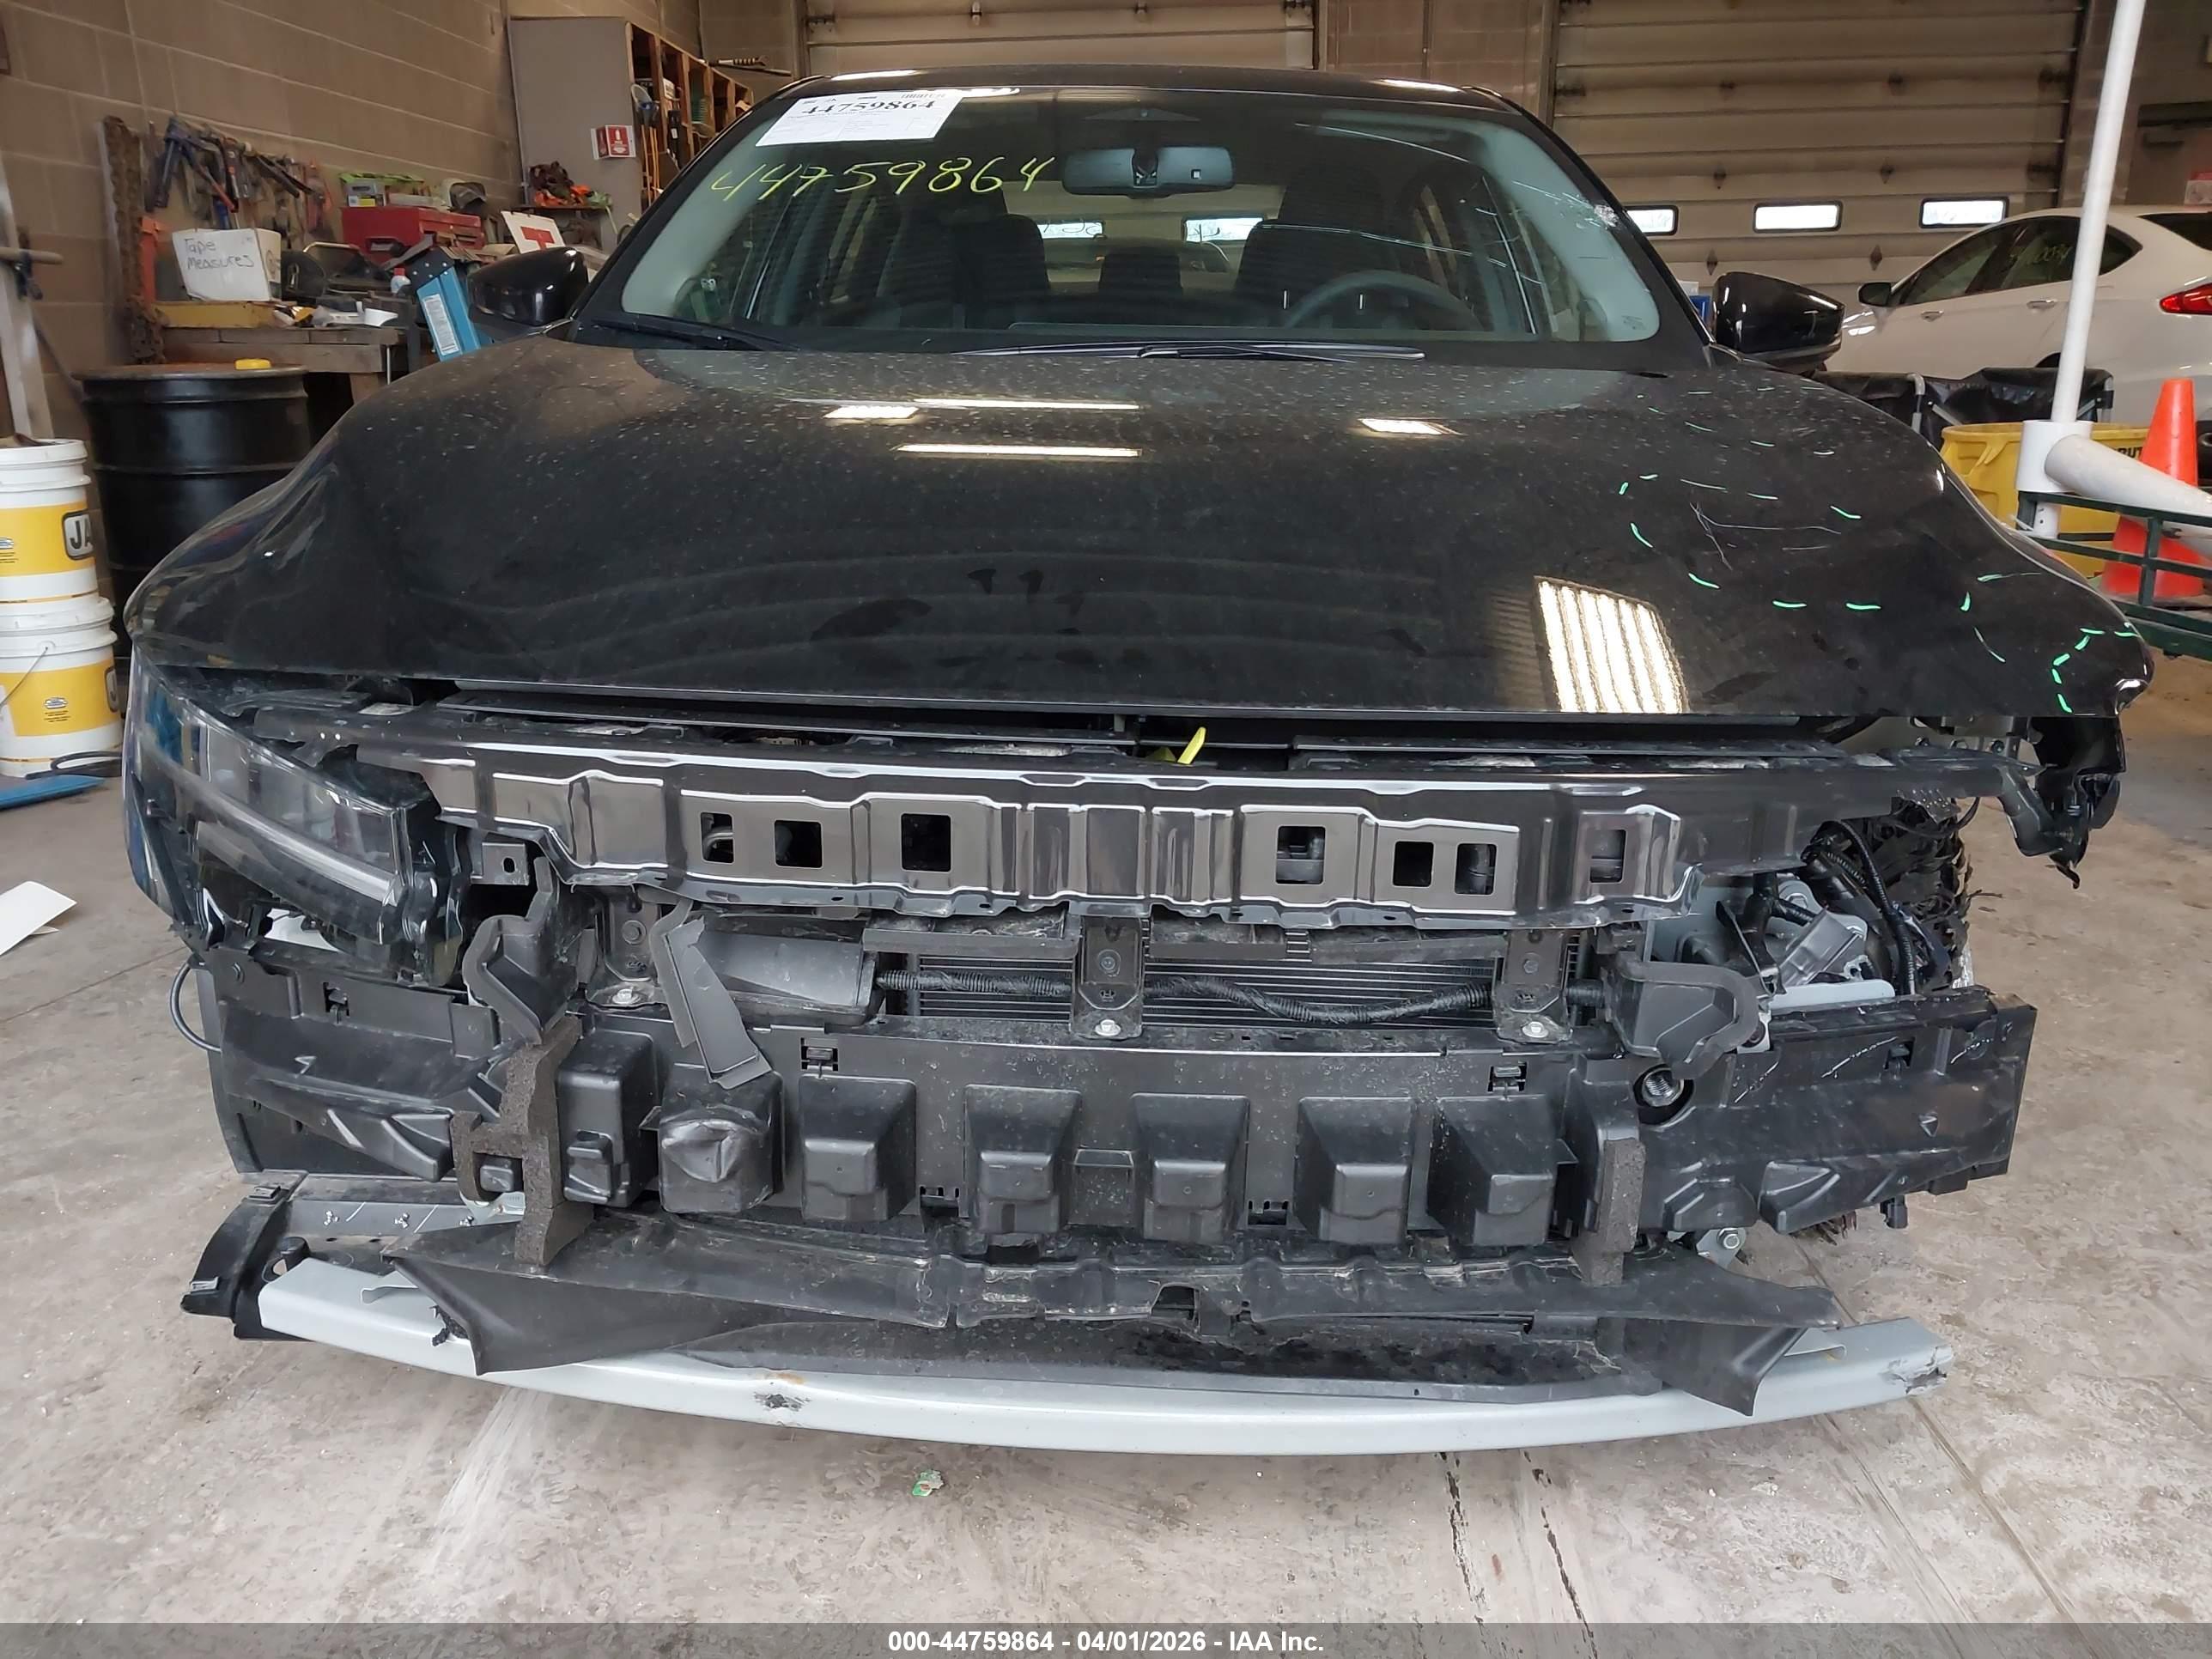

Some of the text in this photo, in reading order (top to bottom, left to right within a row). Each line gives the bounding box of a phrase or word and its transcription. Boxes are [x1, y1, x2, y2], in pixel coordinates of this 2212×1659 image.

[801, 99, 933, 114] 44759864
[710, 156, 1054, 201] 44759864
[185, 239, 216, 254] Tape
